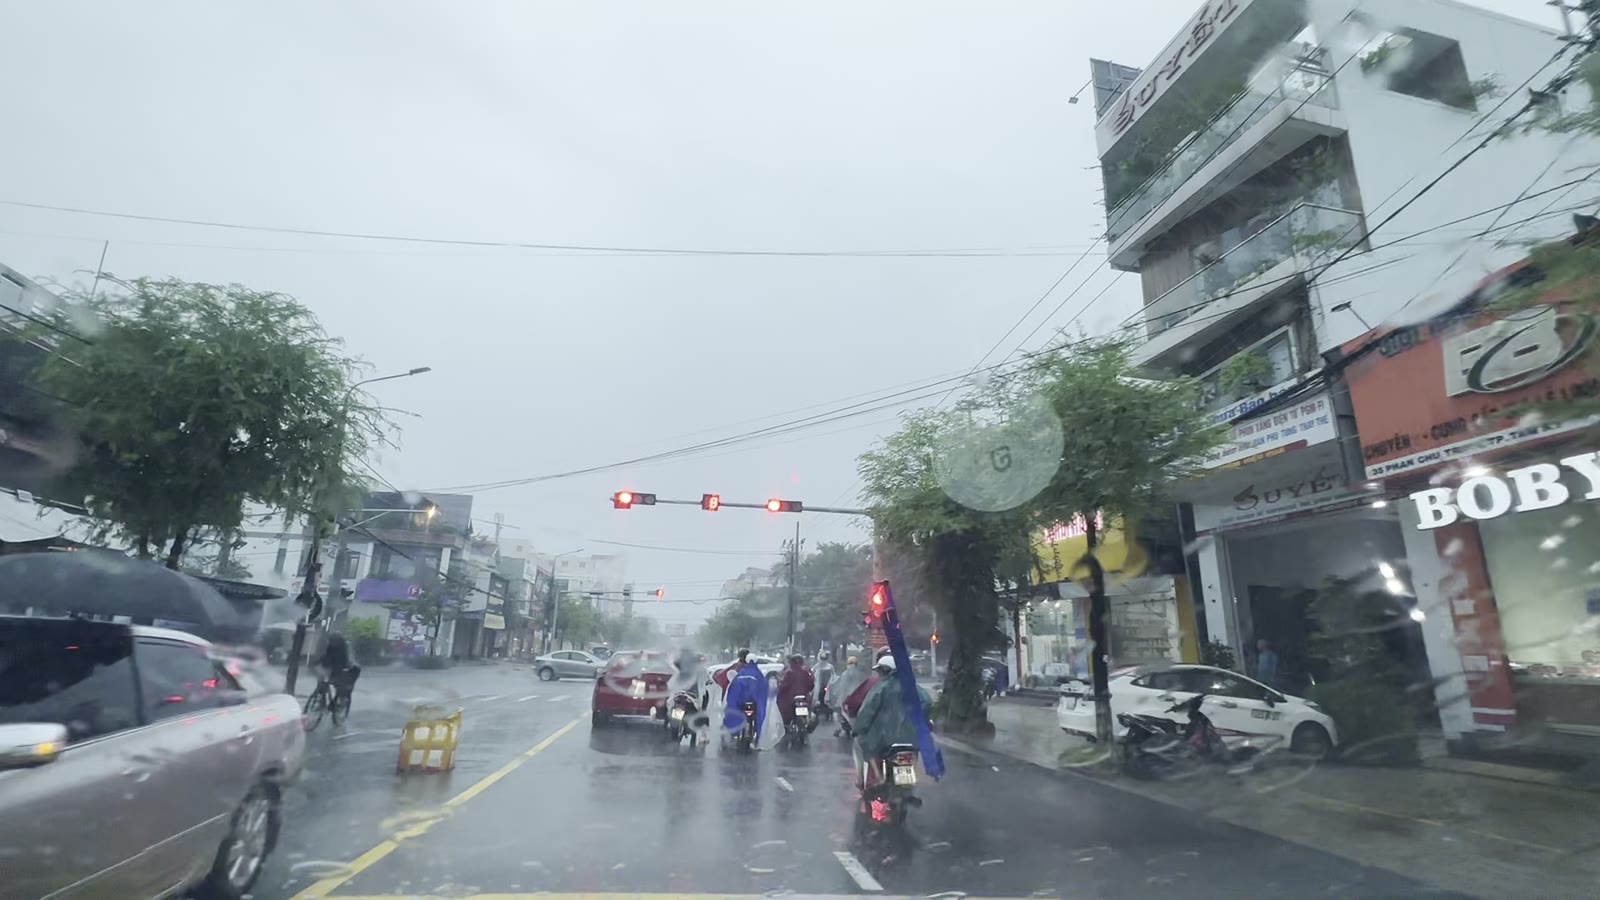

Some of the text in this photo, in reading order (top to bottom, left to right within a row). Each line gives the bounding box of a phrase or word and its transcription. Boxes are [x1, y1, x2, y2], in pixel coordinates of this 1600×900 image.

[1385, 458, 1415, 472] PHAN
[1417, 452, 1441, 464] CHU
[1408, 450, 1600, 531] BOBY
